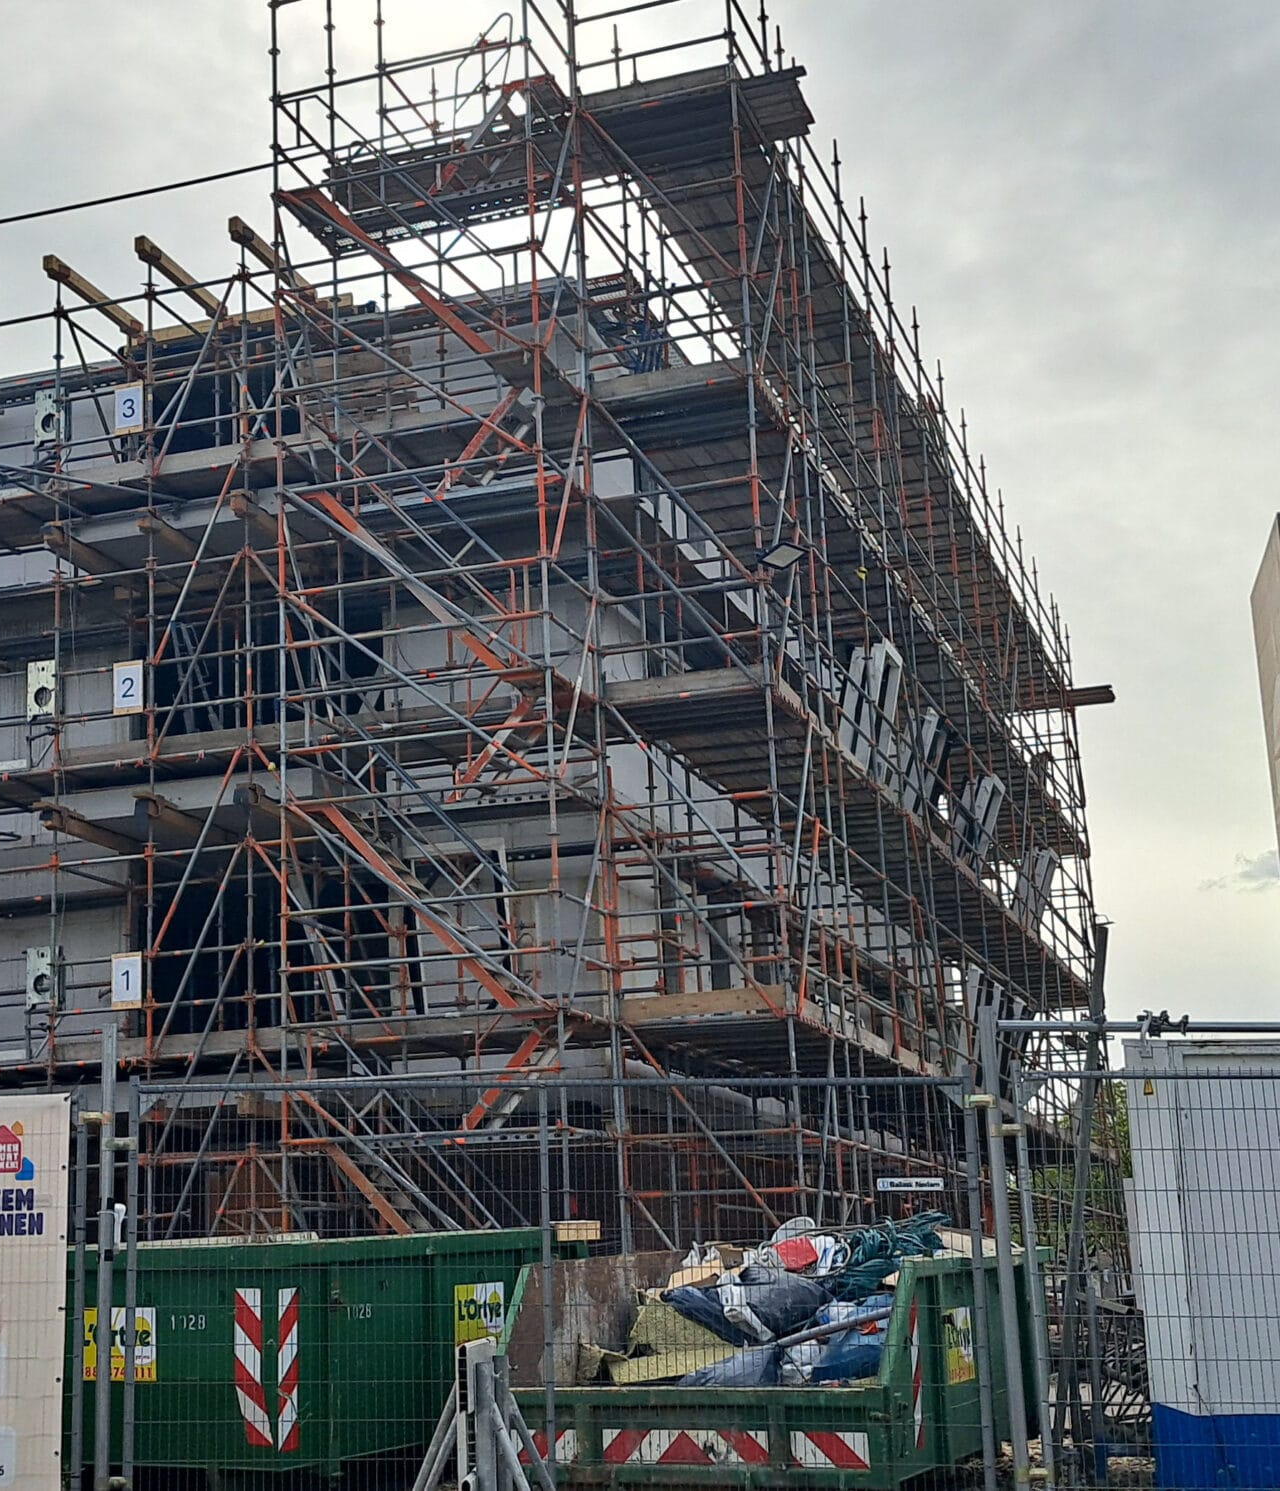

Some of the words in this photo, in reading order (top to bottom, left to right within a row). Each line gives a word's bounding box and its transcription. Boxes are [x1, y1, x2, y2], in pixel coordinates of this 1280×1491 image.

[122, 398, 135, 418] 3
[122, 677, 135, 698] 2
[121, 969, 129, 990] 1
